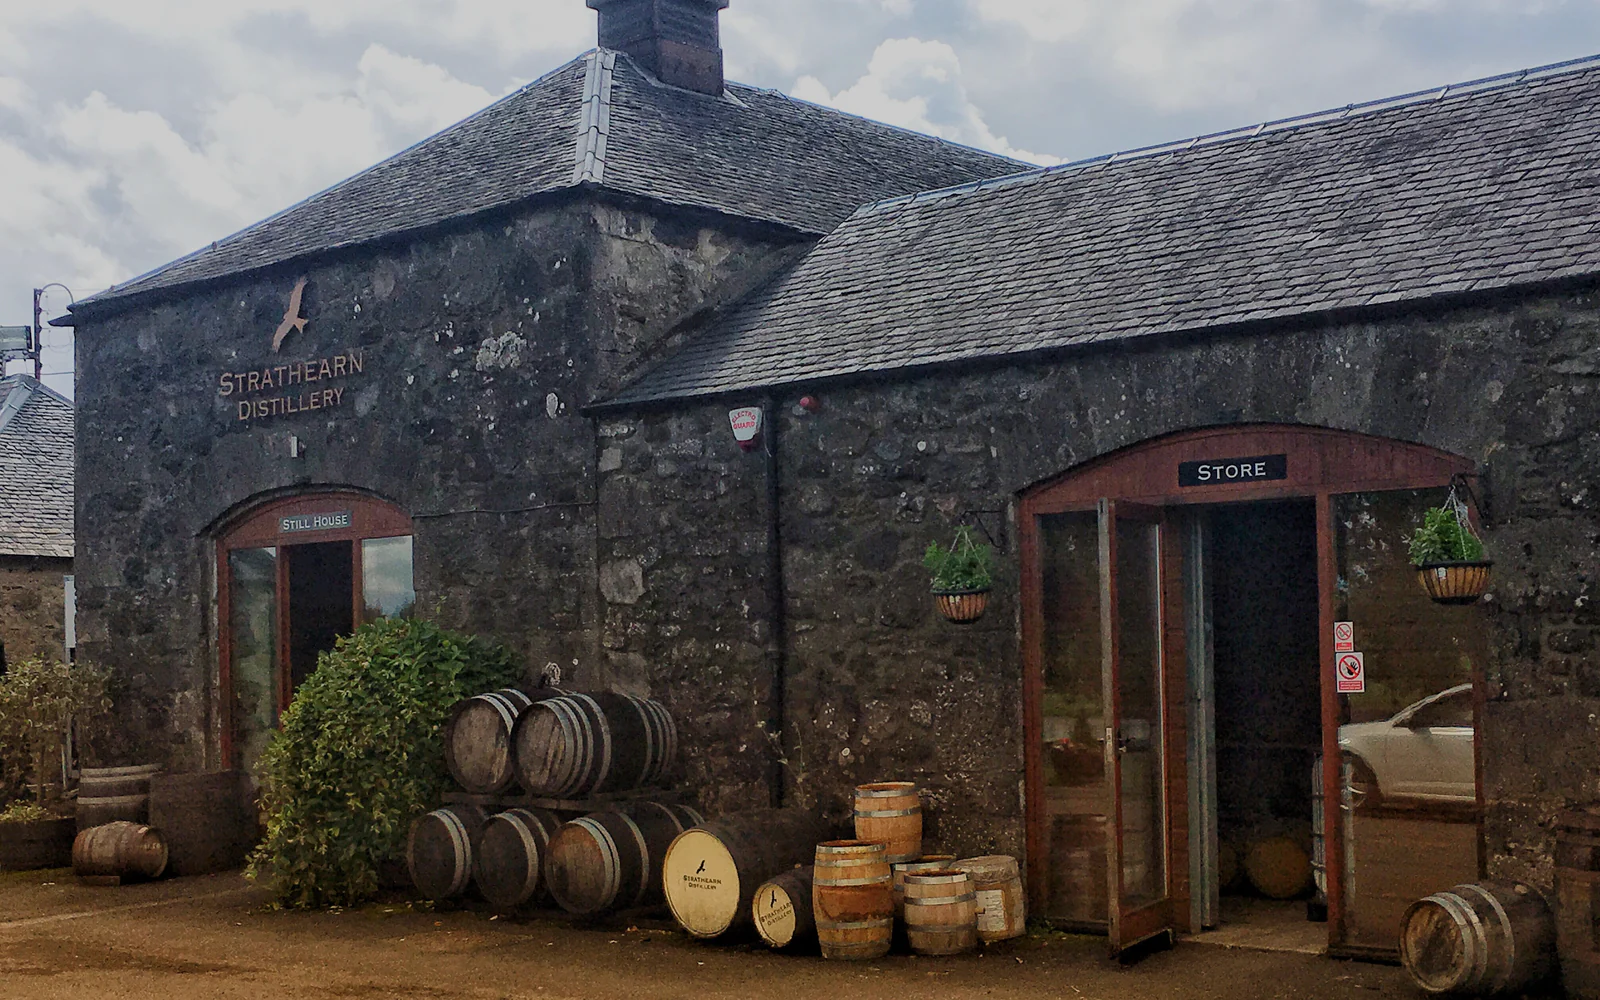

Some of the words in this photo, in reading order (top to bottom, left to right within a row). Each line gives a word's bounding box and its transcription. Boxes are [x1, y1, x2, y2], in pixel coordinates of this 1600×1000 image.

[219, 352, 363, 396] STRATHEARN
[238, 387, 345, 421] DISTILLERY
[732, 411, 756, 423] ELECTRO
[733, 421, 755, 429] GUARD
[1198, 462, 1266, 480] STORE
[283, 519, 310, 530] STILL
[314, 514, 348, 527] HOUSE
[683, 875, 722, 884] STRATHEARN
